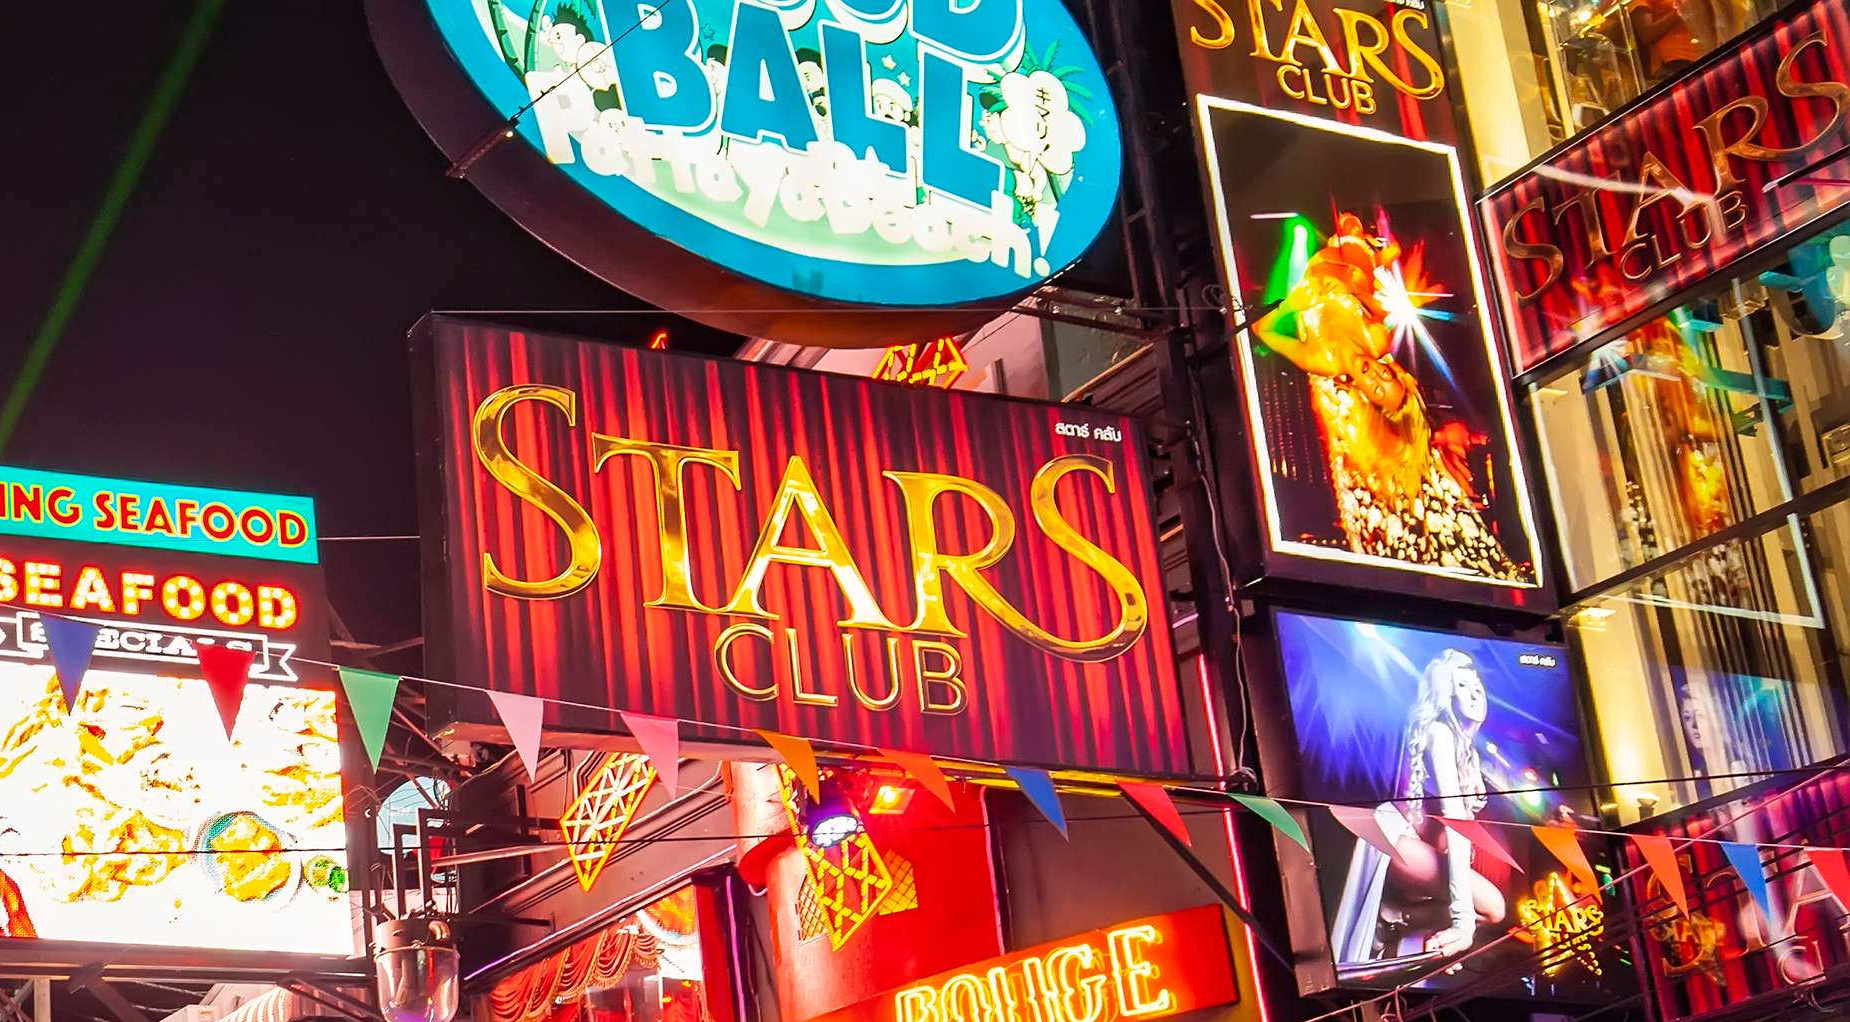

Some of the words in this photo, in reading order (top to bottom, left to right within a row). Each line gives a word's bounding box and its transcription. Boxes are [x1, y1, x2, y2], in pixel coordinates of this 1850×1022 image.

[602, 0, 1008, 212] BALL
[1277, 65, 1377, 115] CLUB
[1620, 190, 1749, 281] CLUB
[93, 490, 311, 550] SEAFOOD
[472, 384, 1149, 664] STARS
[715, 622, 968, 715] CLUB
